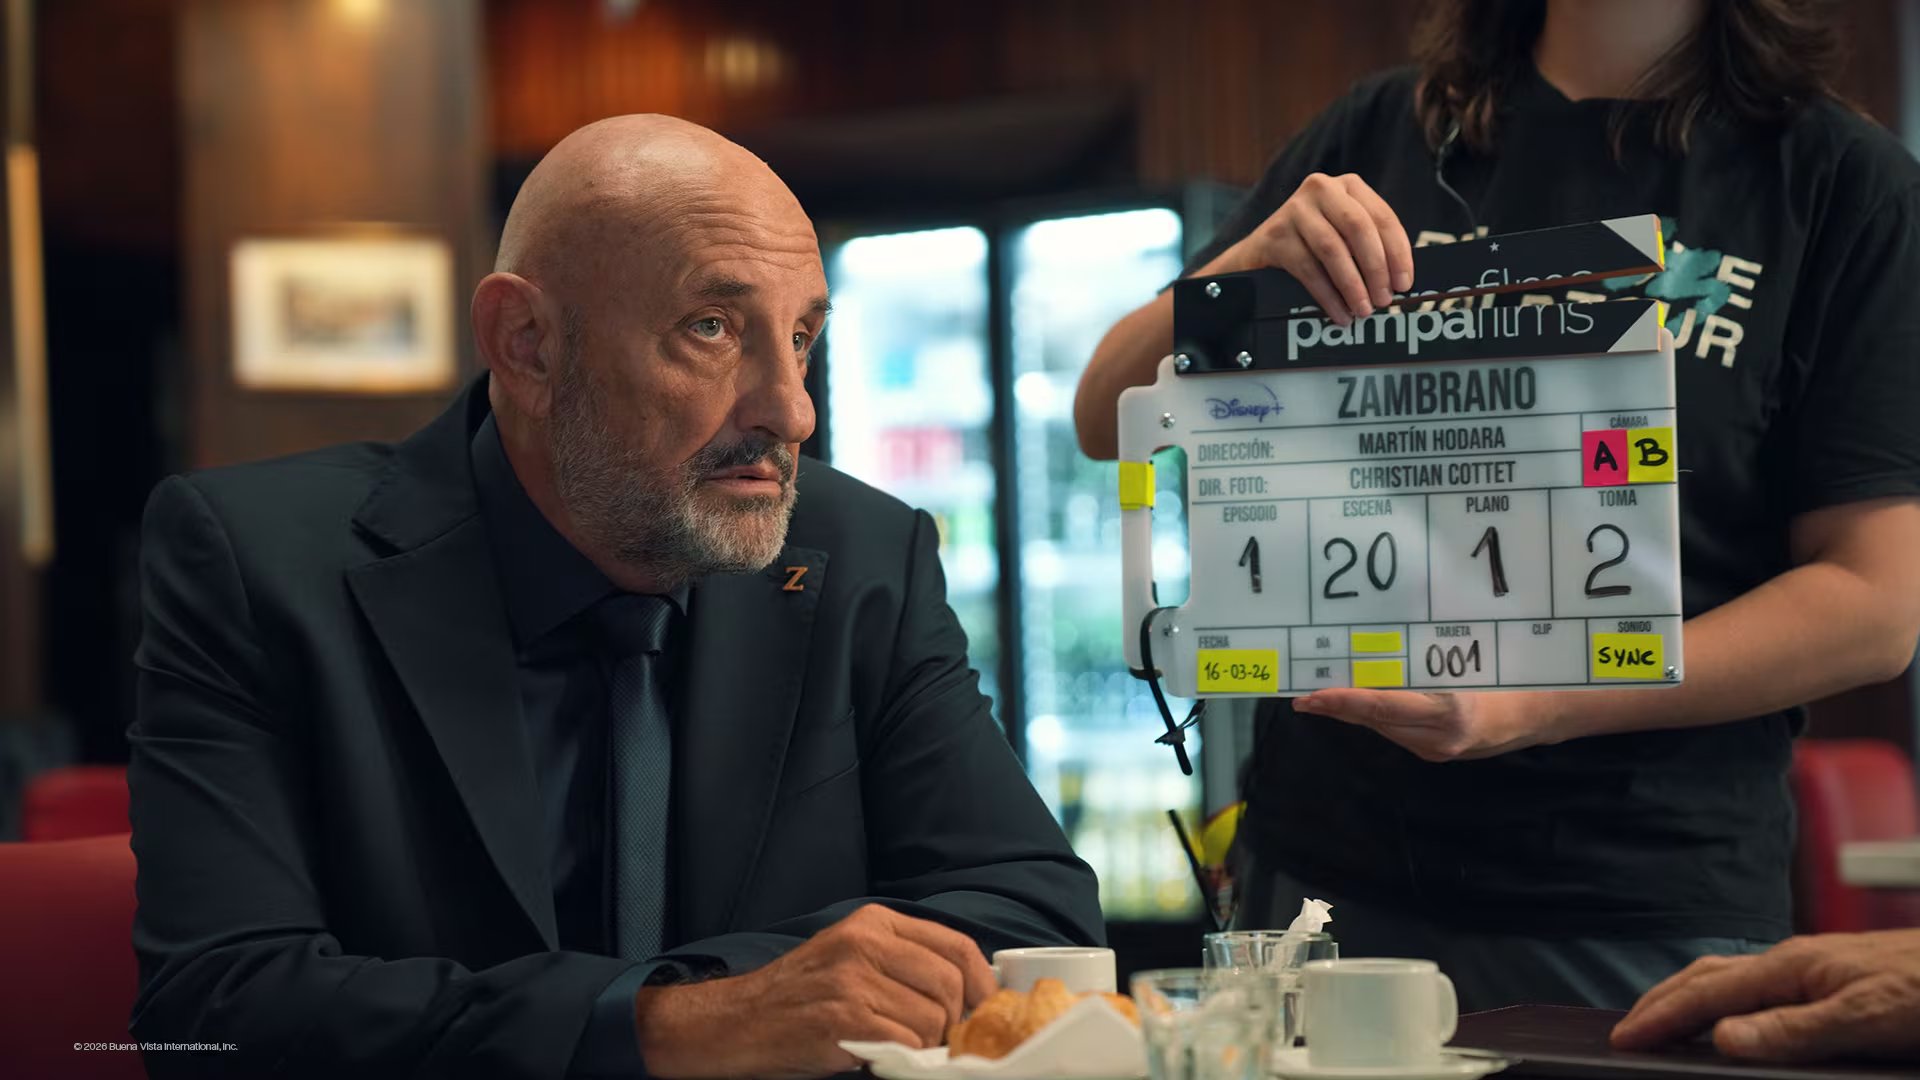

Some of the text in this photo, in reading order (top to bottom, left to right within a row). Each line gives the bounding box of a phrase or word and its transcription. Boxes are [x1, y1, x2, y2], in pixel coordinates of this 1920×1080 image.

[1337, 366, 1537, 419] ZAMBRANO
[1610, 414, 1649, 429] CÁMARA
[1197, 438, 1275, 462] DIRECCIÓN:
[1358, 426, 1506, 455] MARTÍN HODARA
[1593, 437, 1668, 472] A B
[1198, 475, 1268, 497] DIR. FOTO:
[1350, 460, 1516, 490] CHRISTIAN COTTET
[1343, 498, 1393, 518] ESCENA
[1465, 495, 1510, 513] PLANO
[1597, 489, 1638, 508] TOMA
[1222, 504, 1277, 523] EPISODIO
[1238, 535, 1263, 594] 1
[1323, 531, 1398, 600] 20
[1470, 526, 1510, 598] 1
[1584, 523, 1632, 598] 2
[783, 566, 809, 591] Z
[1435, 625, 1471, 638] TARJETA
[1532, 623, 1553, 635] CLIP
[1617, 620, 1652, 633] SONIDO
[1198, 635, 1230, 649] FECHA
[1425, 639, 1482, 678] 001
[1598, 646, 1656, 667] SYNC
